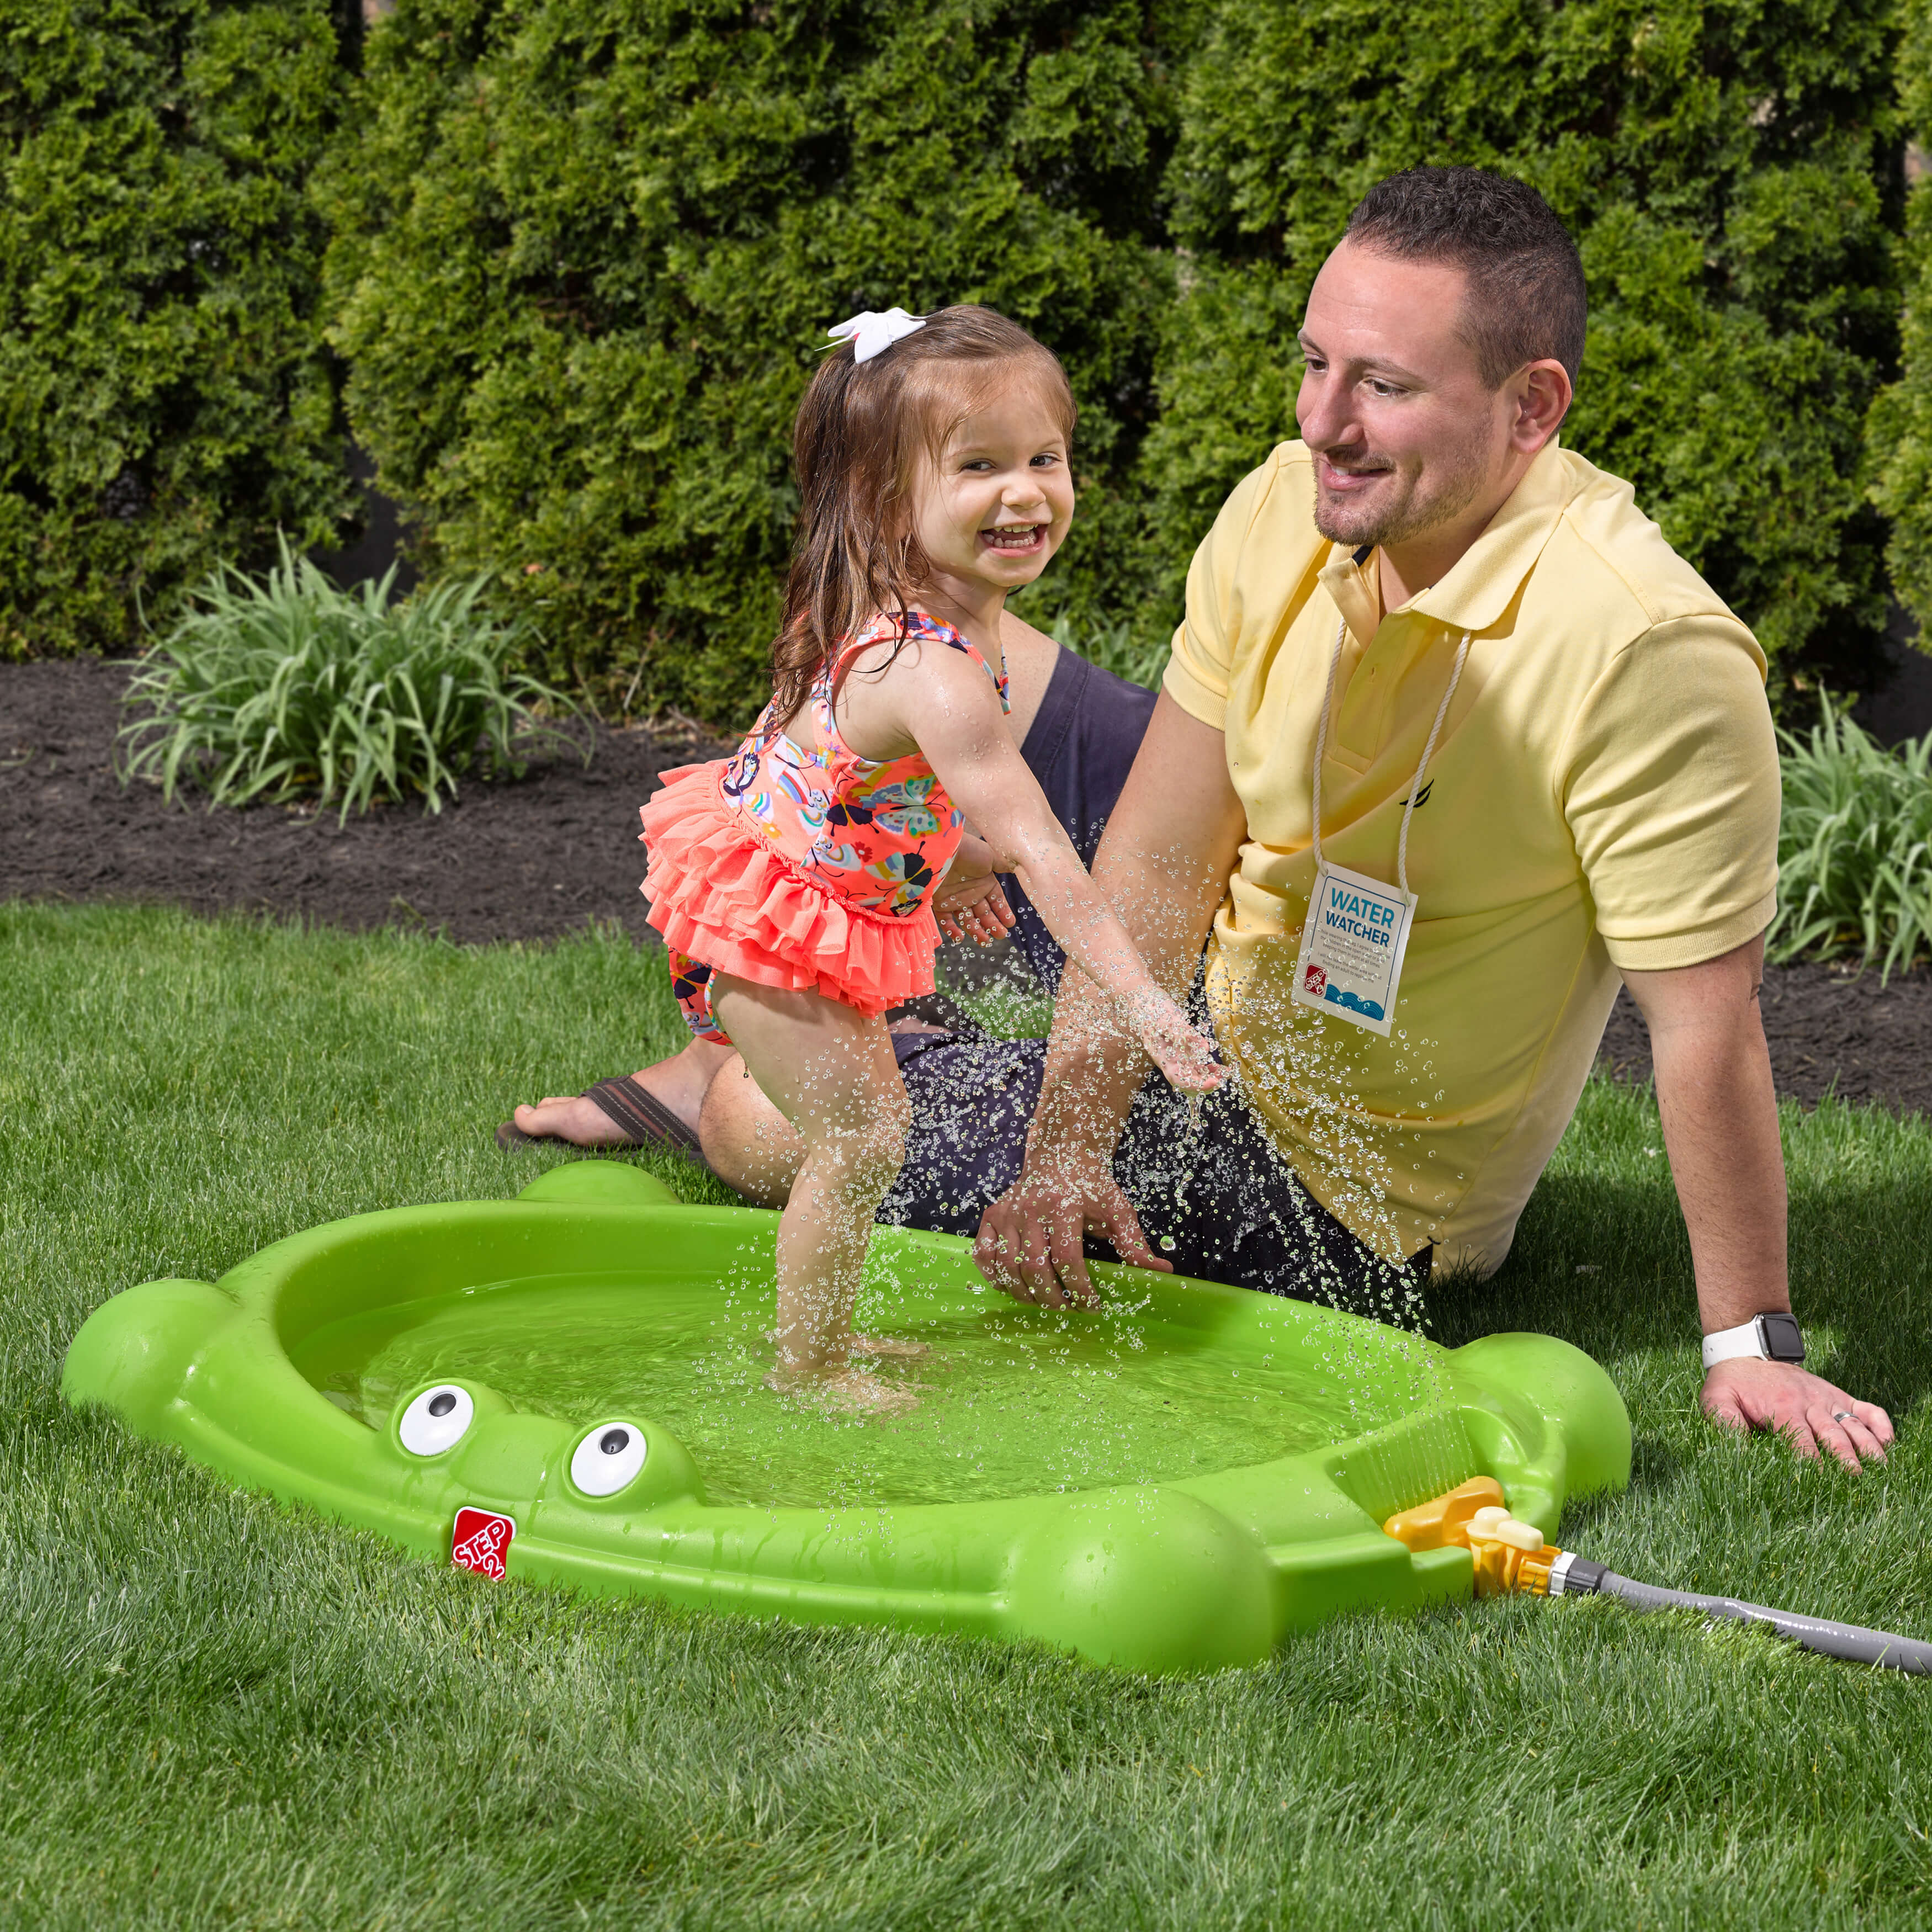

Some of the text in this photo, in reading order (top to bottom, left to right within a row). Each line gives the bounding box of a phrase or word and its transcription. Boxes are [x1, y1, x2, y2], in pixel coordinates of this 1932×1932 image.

[1332, 888, 1394, 929] WATER
[1327, 911, 1389, 947] WATCHER
[453, 1519, 506, 1570] STEP
[483, 1553, 505, 1581] 2
